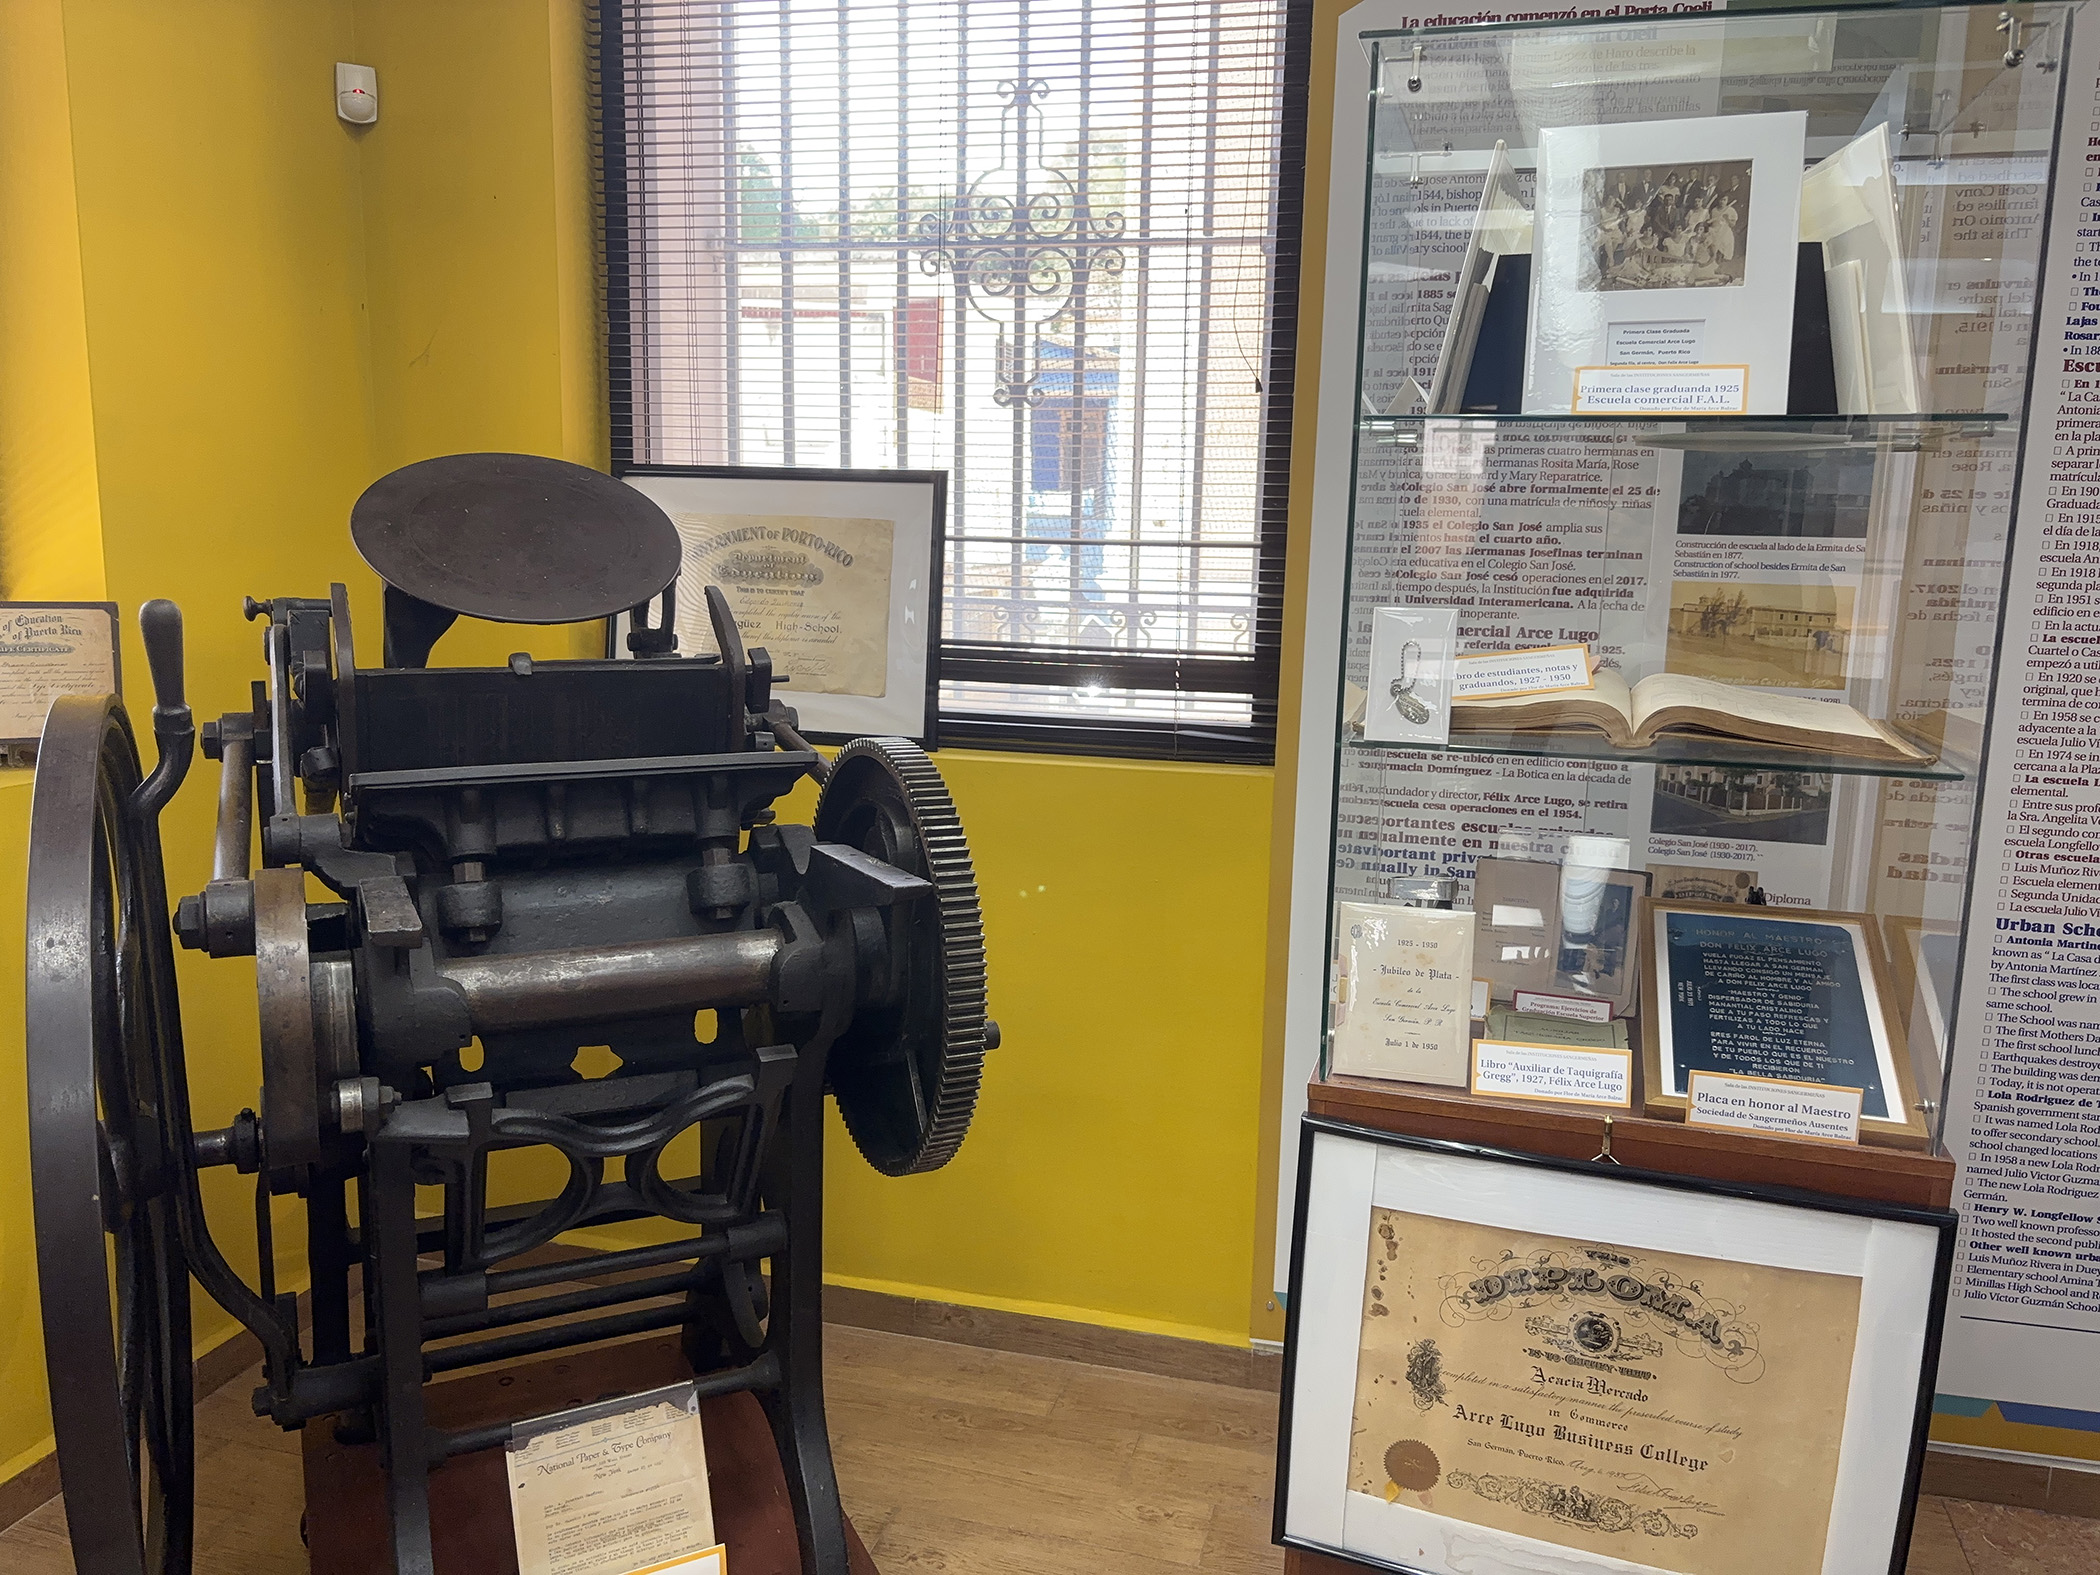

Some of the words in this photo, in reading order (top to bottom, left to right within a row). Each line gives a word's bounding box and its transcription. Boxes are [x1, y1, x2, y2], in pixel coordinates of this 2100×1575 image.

[1401, 16, 1419, 29] La
[1424, 12, 1501, 27] educación
[1506, 8, 1577, 22] comenzó
[1581, 9, 1600, 18] en
[1605, 4, 1619, 16] el
[1625, 4, 1668, 15] Porta
[2066, 317, 2097, 327] Lajas
[1653, 385, 1710, 395] graduanda
[1715, 385, 1739, 393] 1925
[1588, 396, 1632, 404] Escuela
[1634, 396, 1692, 404] comercial
[1697, 396, 1729, 404] F.A.L.
[1401, 482, 1443, 493] Colegio
[1447, 484, 1468, 492] San
[1472, 483, 1496, 493] José
[1499, 484, 1526, 493] abre
[1530, 485, 1608, 495] formalmente
[1613, 486, 1623, 495] el
[1628, 487, 1641, 495] 25
[1646, 486, 1660, 496] de
[1401, 545, 1411, 553] el
[1415, 546, 1441, 554] 2007
[1446, 546, 1461, 555] las
[1466, 547, 1525, 556] Hermanas
[1530, 548, 1582, 558] Josefinas
[1587, 550, 1642, 559] terminan
[1674, 560, 1723, 568] Construction
[1734, 562, 1759, 570] school
[1761, 562, 1790, 570] besides
[1831, 564, 1845, 572] San
[3, 620, 12, 632] of
[15, 614, 63, 626] Education
[13, 631, 21, 640] of
[61, 624, 82, 635] Rico
[1516, 627, 1553, 639] Arce
[1559, 628, 1598, 642] Lugo
[1455, 672, 1472, 680] bro
[1487, 667, 1543, 678] estudiantes,
[1459, 677, 1516, 691] graduandos,
[1520, 676, 1540, 684] 1927
[2011, 787, 2068, 798] elemental.
[1649, 837, 1677, 847] Colegio
[1678, 839, 1692, 847] San
[1693, 841, 1708, 849] José
[1710, 842, 1730, 850] (1930
[1736, 844, 1758, 852] 2017).
[1764, 893, 1811, 907] Diploma
[1996, 918, 2055, 933] Urban
[1696, 929, 1734, 937] HONOR
[1765, 934, 1822, 945] MAESTRO
[2007, 936, 2053, 947] Antonia
[1728, 943, 1756, 951] FELIX
[1764, 945, 1791, 954] ARCE
[1798, 949, 1828, 958] LUGO
[1380, 965, 1411, 976] Jubileo
[1415, 968, 1424, 977] de
[1429, 969, 1451, 980] Plata
[1990, 973, 2009, 984] The
[2011, 974, 2030, 985] first
[2032, 977, 2055, 987] class
[2058, 980, 2077, 989] was
[1986, 1001, 2014, 1010] same
[2016, 1003, 2052, 1013] school.
[1385, 1038, 1402, 1047] Julio
[1412, 1040, 1419, 1049] de
[1481, 1060, 1506, 1069] Libro
[1508, 1062, 1551, 1073] “Auxiliar
[1553, 1066, 1565, 1075] de
[1567, 1067, 1623, 1082] Taquigrafía
[1483, 1071, 1518, 1083] Gregg”,
[1522, 1074, 1546, 1085] 1927,
[1550, 1077, 1572, 1087] Félix
[1574, 1079, 1595, 1089] Arce
[1599, 1081, 1622, 1092] Lugo
[1698, 1092, 1728, 1104] Placa
[1749, 1098, 1785, 1112] honor
[1788, 1103, 1798, 1113] al
[1802, 1104, 1851, 1120] Maestro
[1988, 1090, 2011, 1100] Lola
[2016, 1093, 2075, 1107] Rodriguez
[2079, 1098, 2092, 1108] de
[1697, 1107, 1735, 1118] Sociedad
[1737, 1111, 1747, 1119] de
[1749, 1113, 1806, 1127] Sangermeños
[1809, 1121, 1848, 1132] Ausentes
[1974, 1203, 2009, 1216] Henry
[2013, 1206, 2027, 1216] W.
[2030, 1209, 2093, 1224] Longfellow
[1970, 1241, 2002, 1251] Other
[2006, 1245, 2029, 1255] well
[2033, 1247, 2071, 1259] known
[1964, 1289, 1987, 1300] Julio
[2021, 1295, 2064, 1308] Guzmán
[1469, 1266, 1724, 1351] DIPLOMA
[1531, 1365, 1584, 1388] Acacia
[1587, 1376, 1648, 1402] Mercado
[1548, 1409, 1560, 1417] in
[1452, 1404, 1494, 1425] Arce
[1500, 1414, 1545, 1437] Lugo
[1553, 1423, 1633, 1456] Business
[1640, 1443, 1708, 1472] College
[537, 1457, 575, 1476] National
[576, 1452, 600, 1463] Paper
[611, 1442, 634, 1453] Type
[636, 1431, 672, 1448] Company
[1467, 1438, 1482, 1447] San
[1517, 1449, 1543, 1461] Puerto
[594, 1472, 606, 1480] New
[608, 1468, 622, 1476] York
